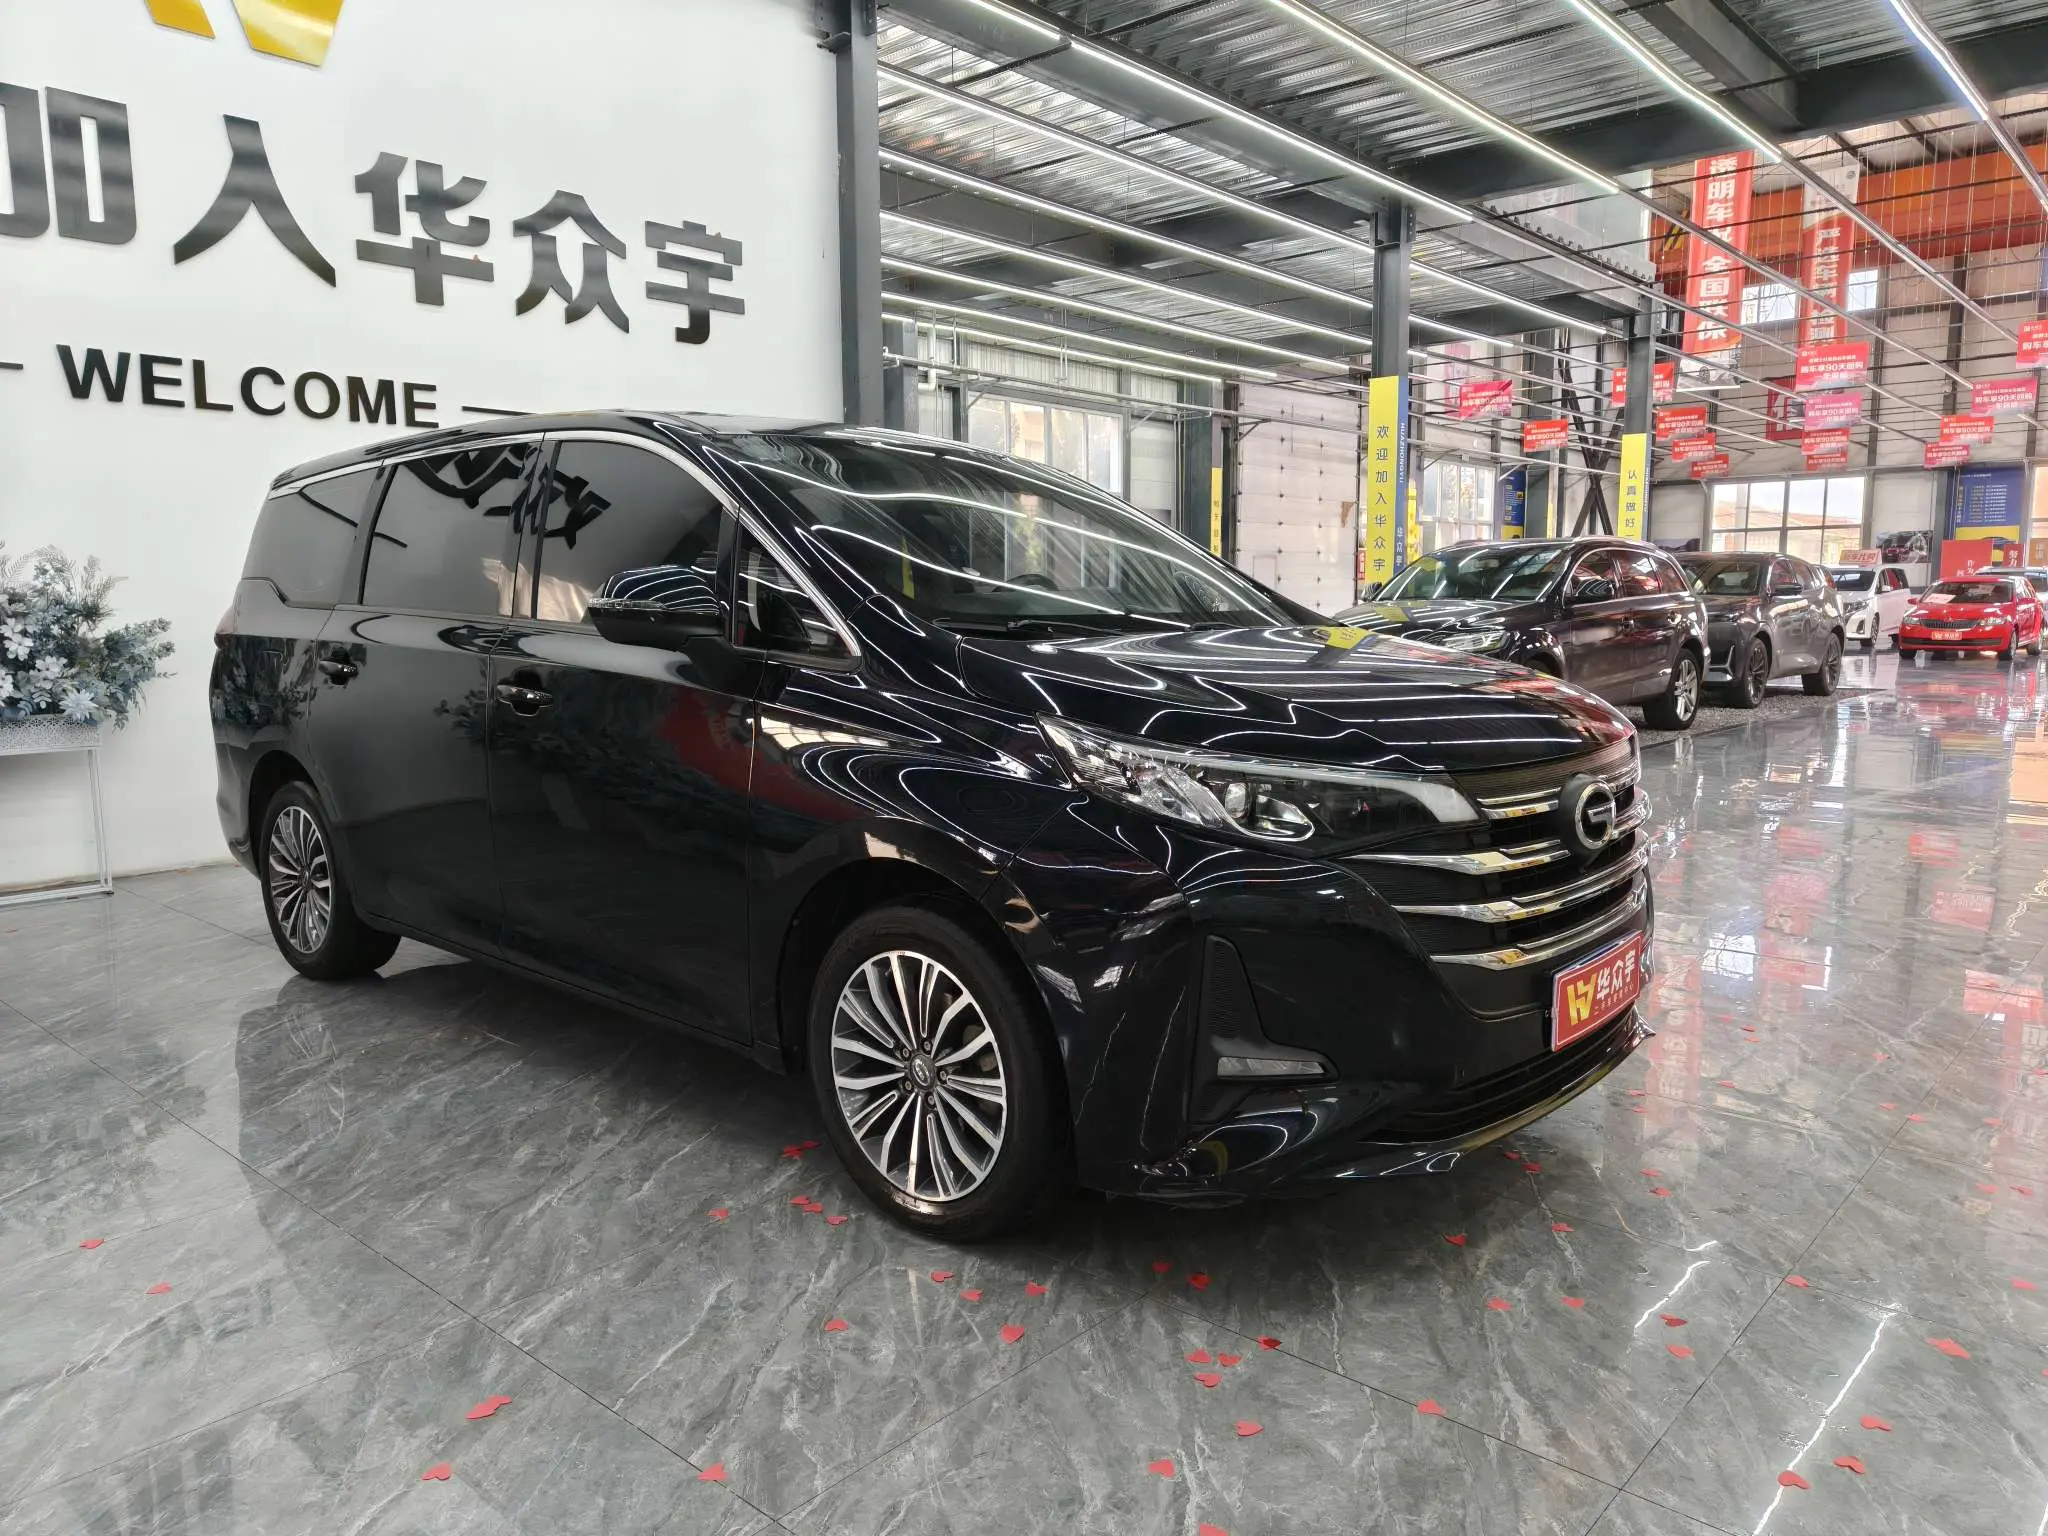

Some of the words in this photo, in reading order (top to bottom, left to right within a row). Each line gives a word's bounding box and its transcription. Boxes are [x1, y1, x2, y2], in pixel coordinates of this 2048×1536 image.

[56, 344, 440, 429] WELCOME
[1374, 424, 1389, 572] 欢迎加入华众宇
[1596, 949, 1636, 1000] 华众宇
